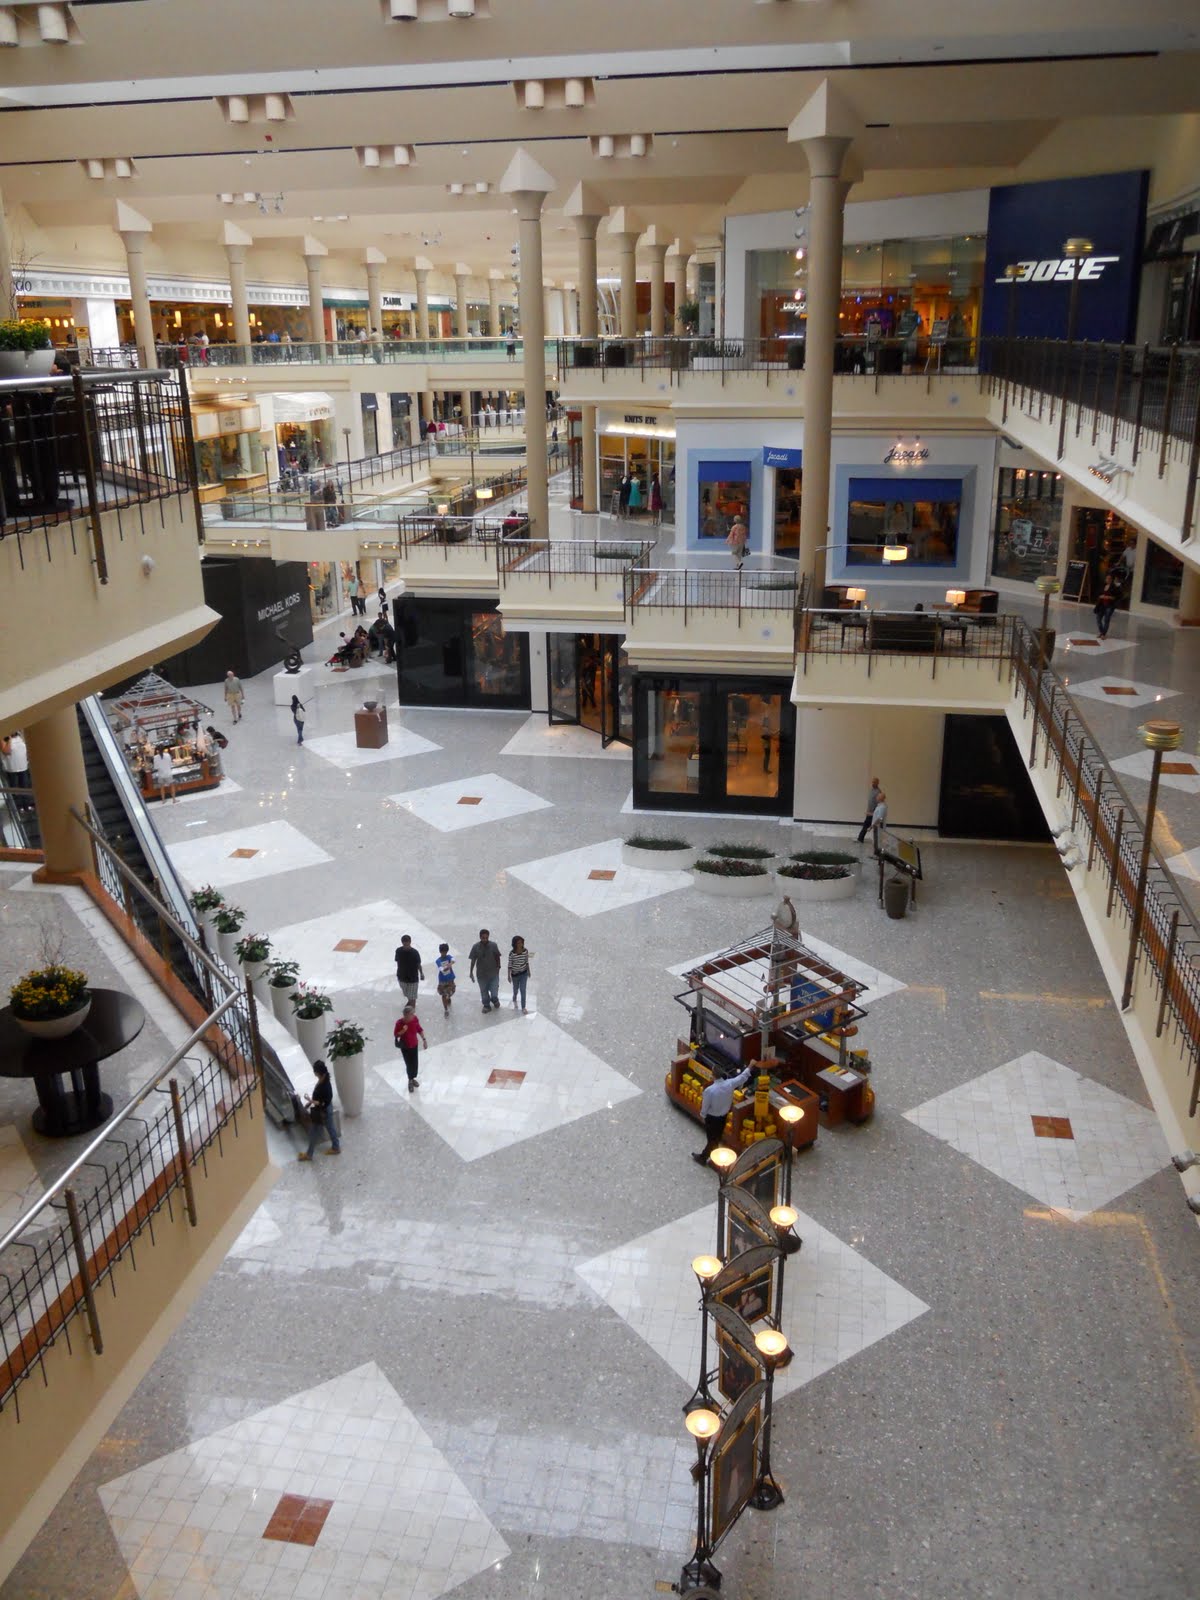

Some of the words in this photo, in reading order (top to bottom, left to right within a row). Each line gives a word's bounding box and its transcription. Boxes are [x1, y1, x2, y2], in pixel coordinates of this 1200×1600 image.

[995, 256, 1120, 283] BOSE
[624, 415, 643, 424] KNITS
[258, 601, 284, 621] MICHAEL
[285, 592, 300, 607] KORS
